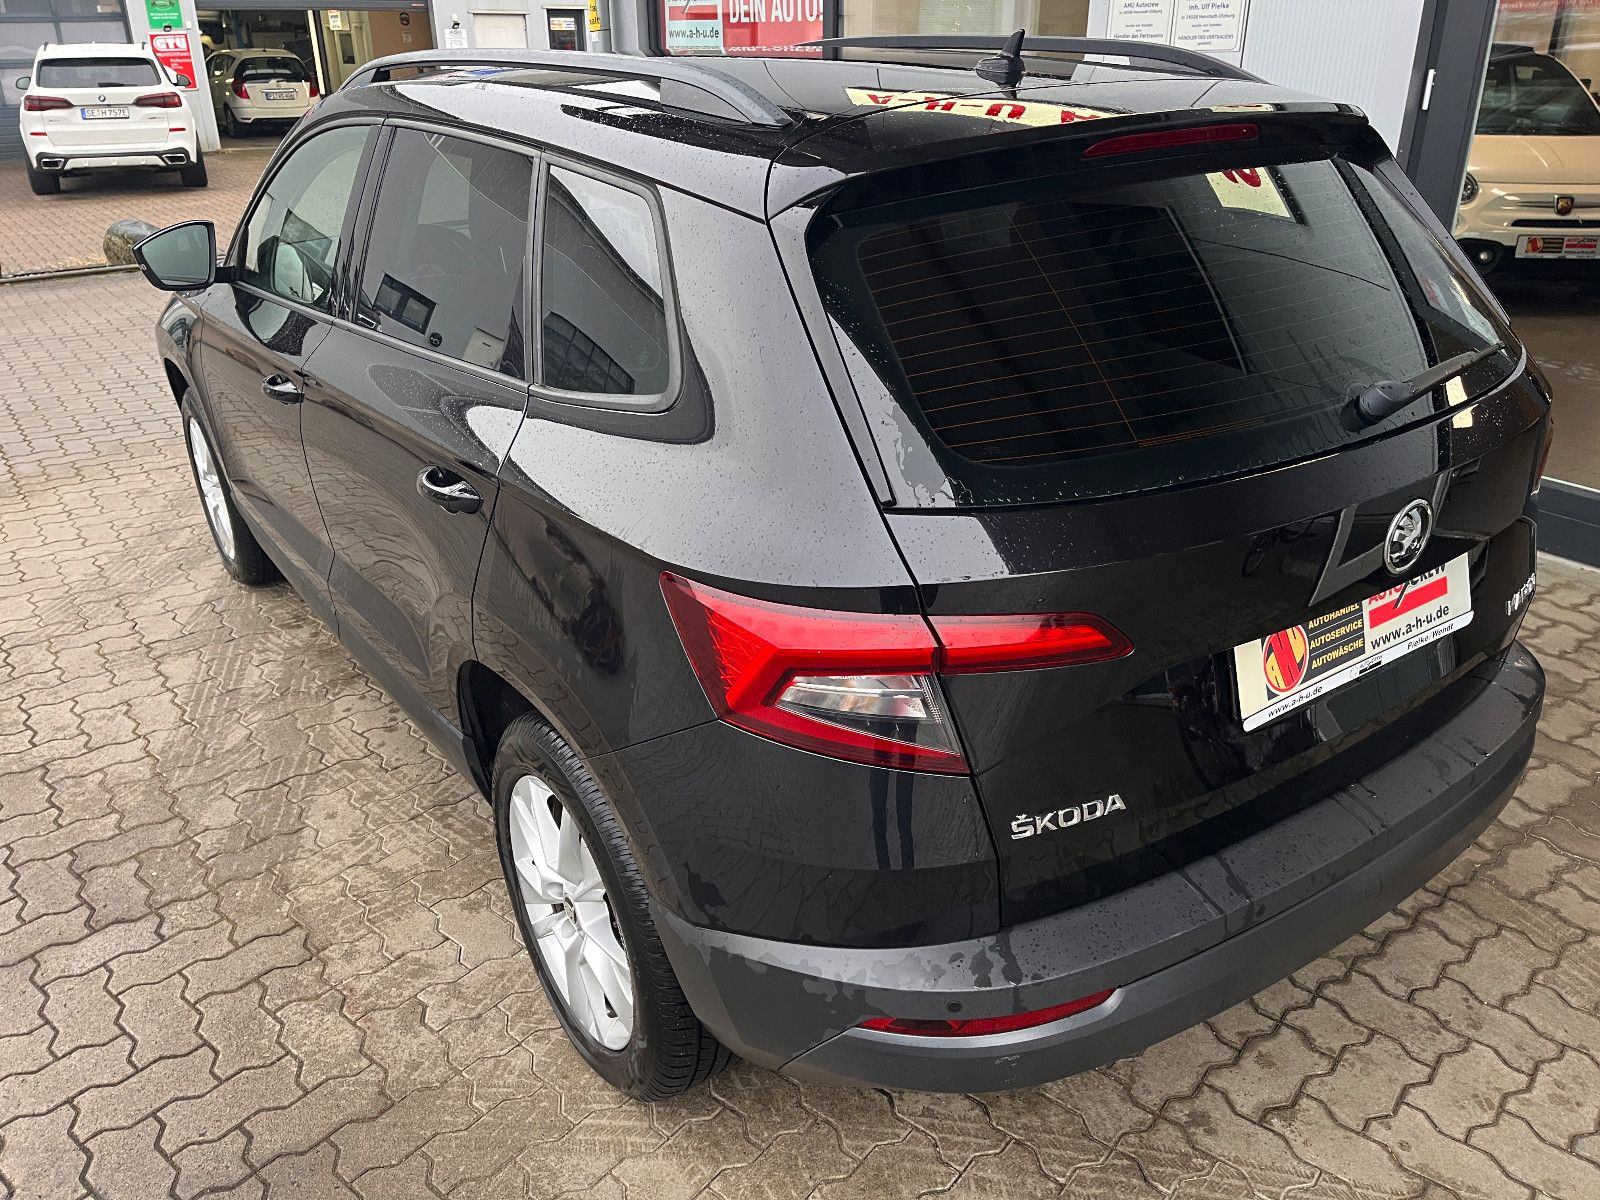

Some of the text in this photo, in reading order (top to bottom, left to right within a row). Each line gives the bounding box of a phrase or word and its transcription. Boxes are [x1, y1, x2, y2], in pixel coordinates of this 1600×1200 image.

[729, 0, 766, 23] DEIN
[668, 27, 720, 39] www.a-h-u.de
[1309, 619, 1364, 650] AUTOSERVICE
[1370, 605, 1450, 650] www.a-h-u.de
[1311, 638, 1365, 670] AUTOWÄSCHE
[1267, 685, 1323, 718] www.a-h-u.de
[1010, 794, 1127, 840] ŠKODA
